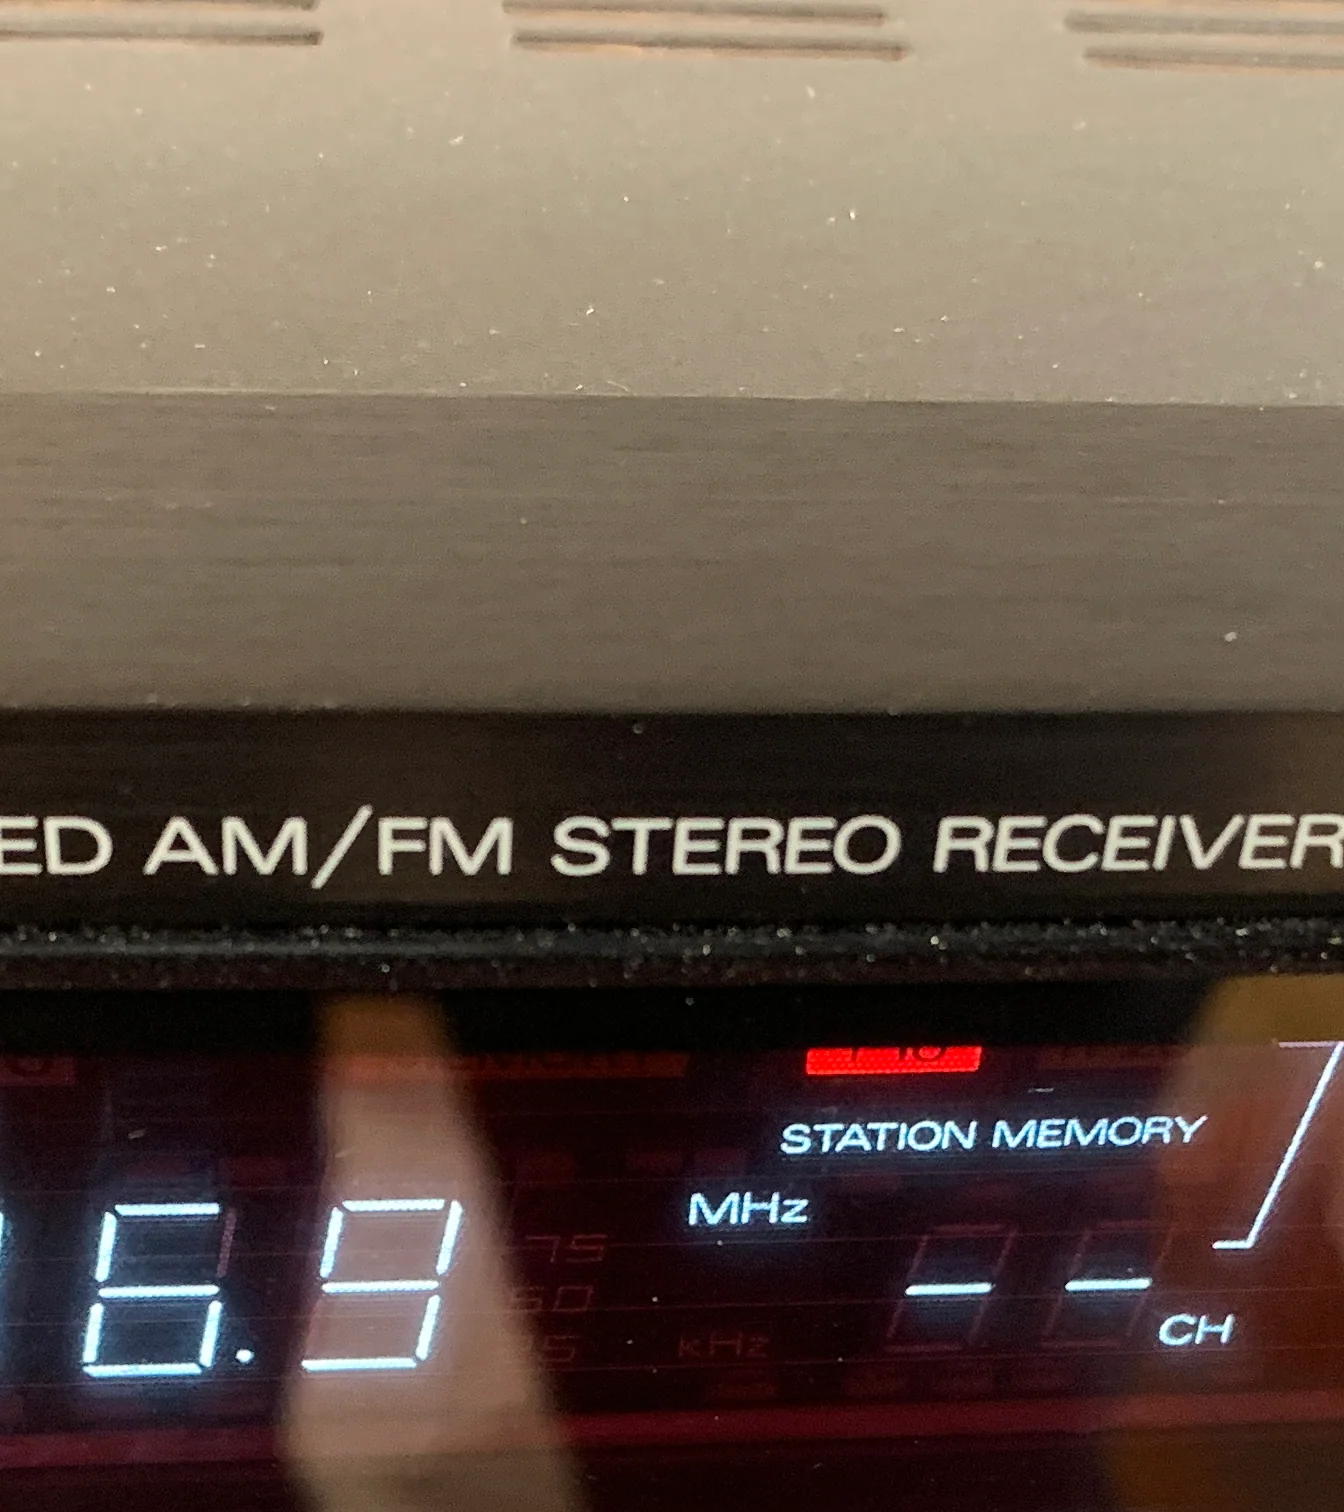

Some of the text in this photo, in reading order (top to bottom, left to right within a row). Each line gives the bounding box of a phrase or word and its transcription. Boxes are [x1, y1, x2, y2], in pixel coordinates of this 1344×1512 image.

[143, 805, 512, 888] AM/FM
[551, 815, 902, 877] STEREO
[779, 1115, 1206, 1155] STATION MEMORY
[687, 1192, 809, 1227] MHz
[1157, 1314, 1234, 1347] CH
